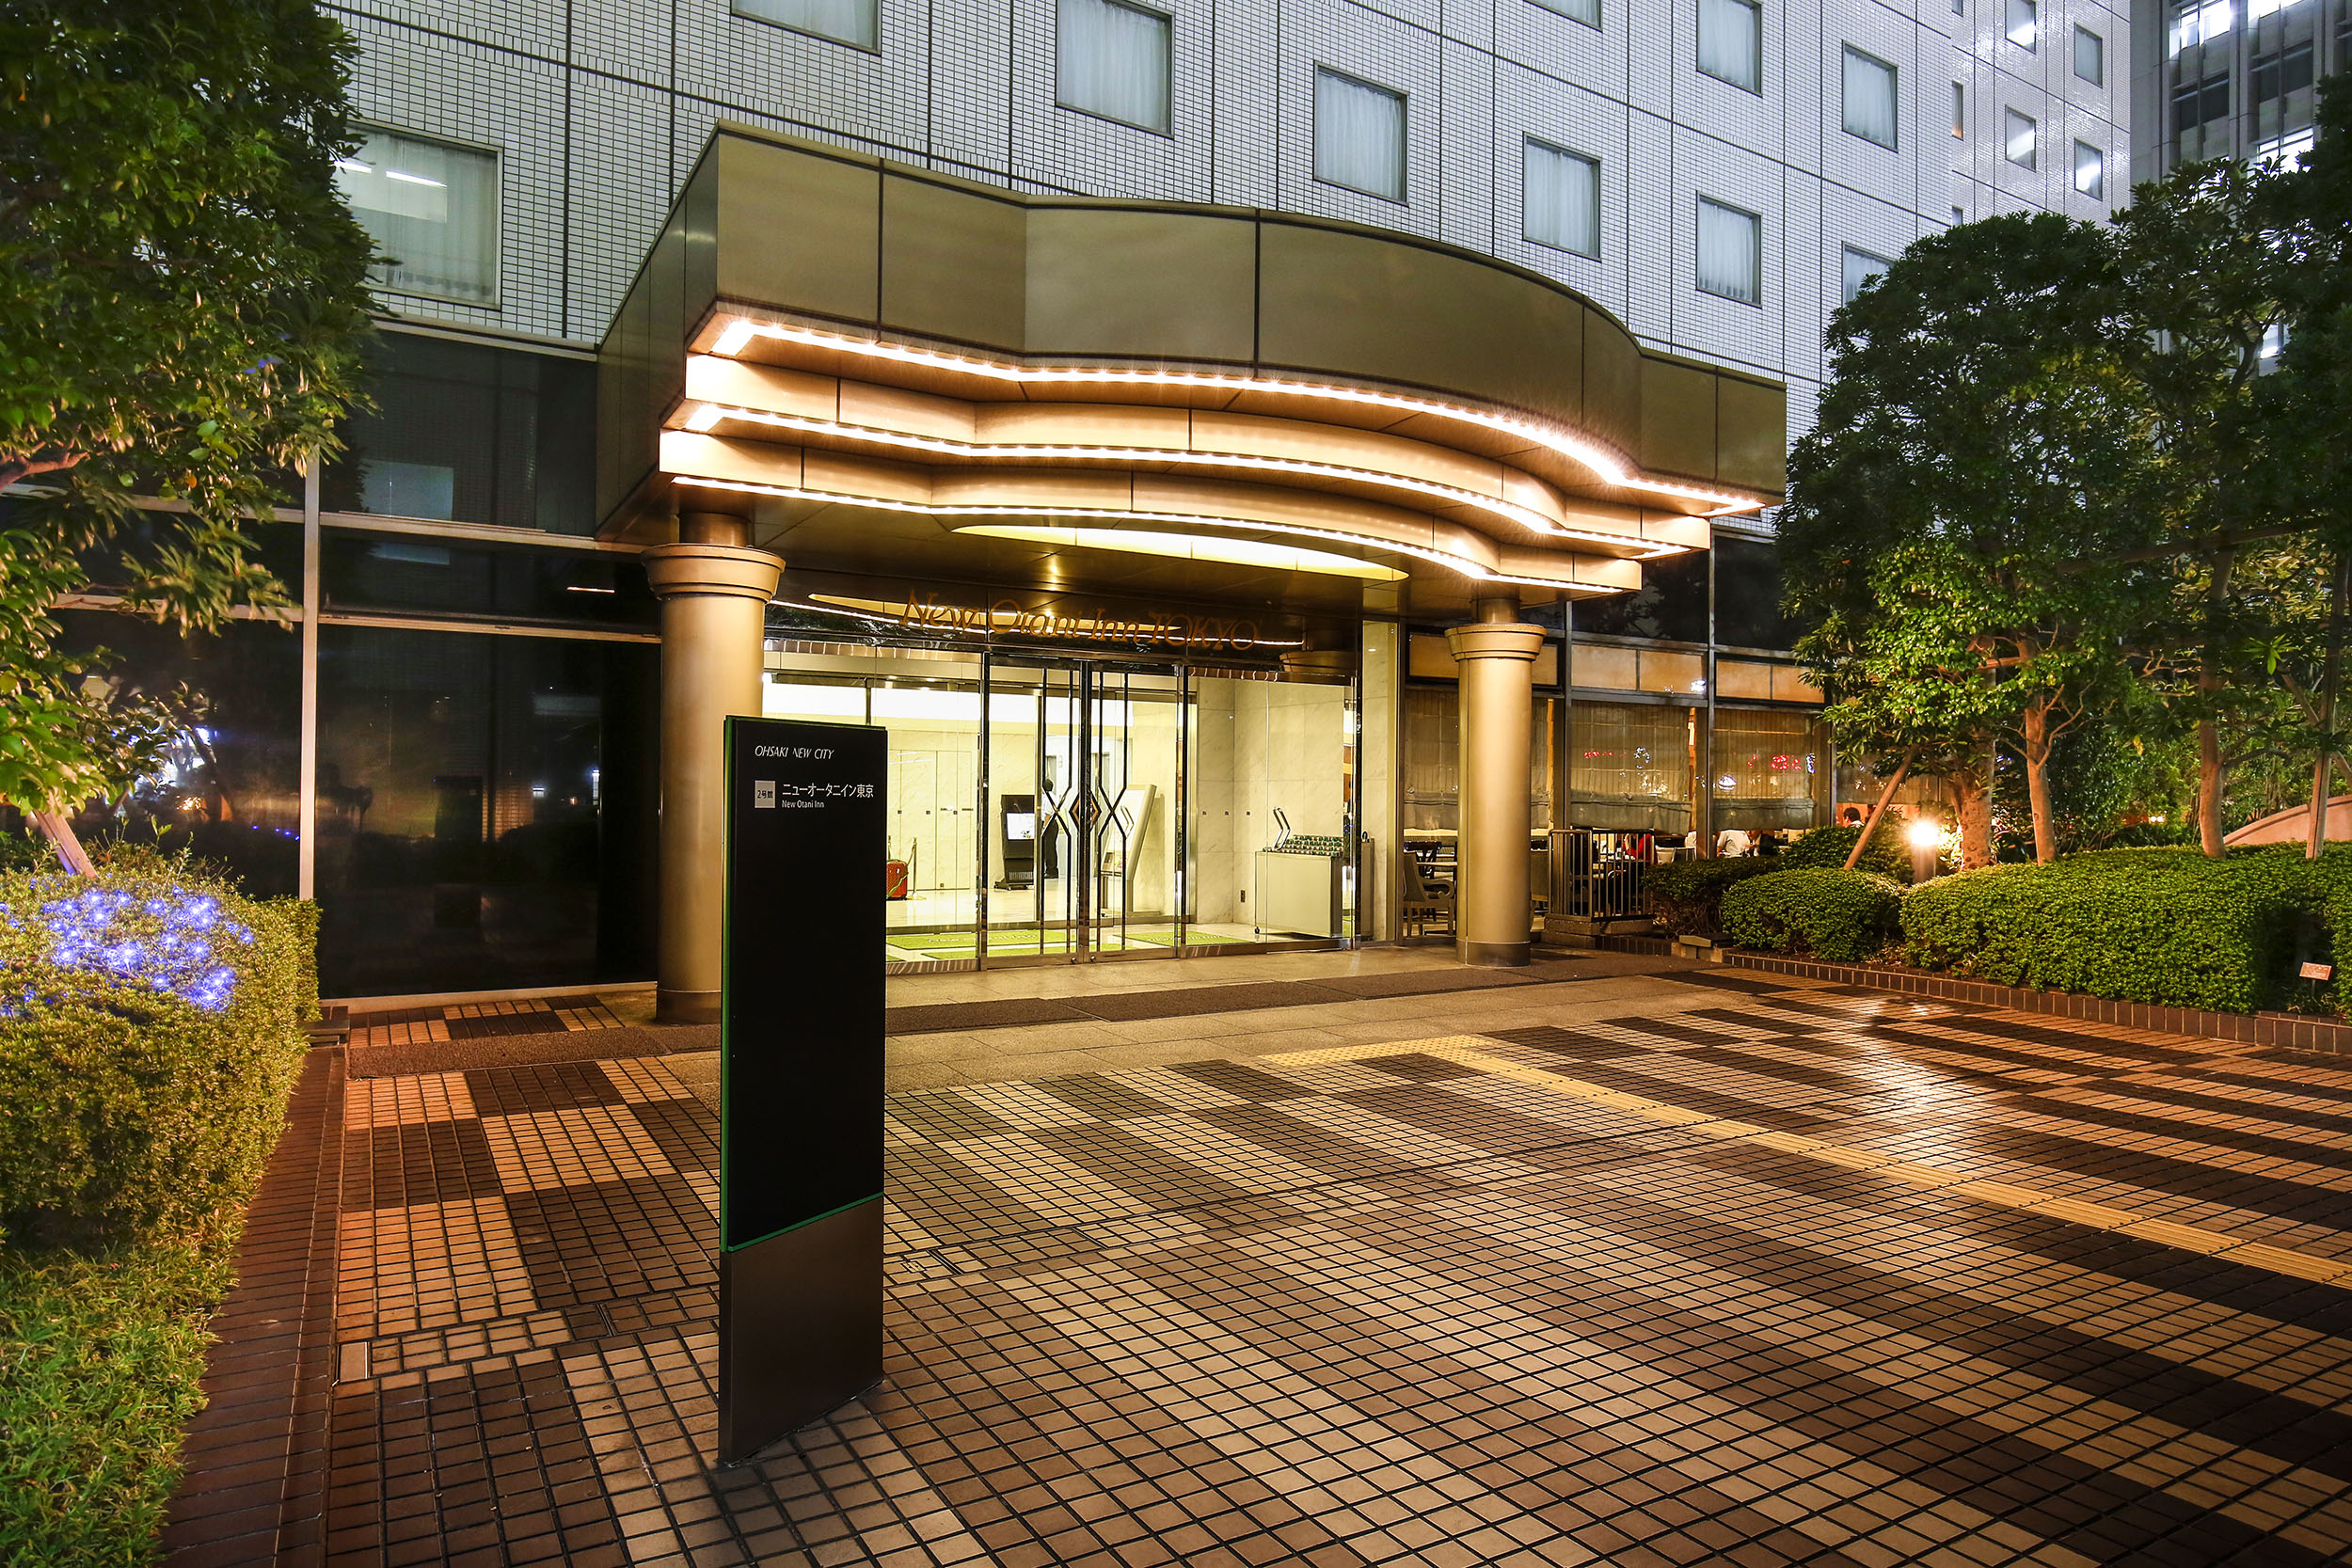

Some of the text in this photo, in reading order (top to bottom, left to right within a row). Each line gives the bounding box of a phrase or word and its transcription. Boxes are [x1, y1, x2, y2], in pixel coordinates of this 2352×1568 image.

[898, 588, 1258, 651] New Otani Inn TOKYO
[755, 744, 834, 760] OHSAKI NEW CITY
[782, 782, 874, 799] ニューオータニイン東京
[781, 800, 825, 809] New Otani Inn
